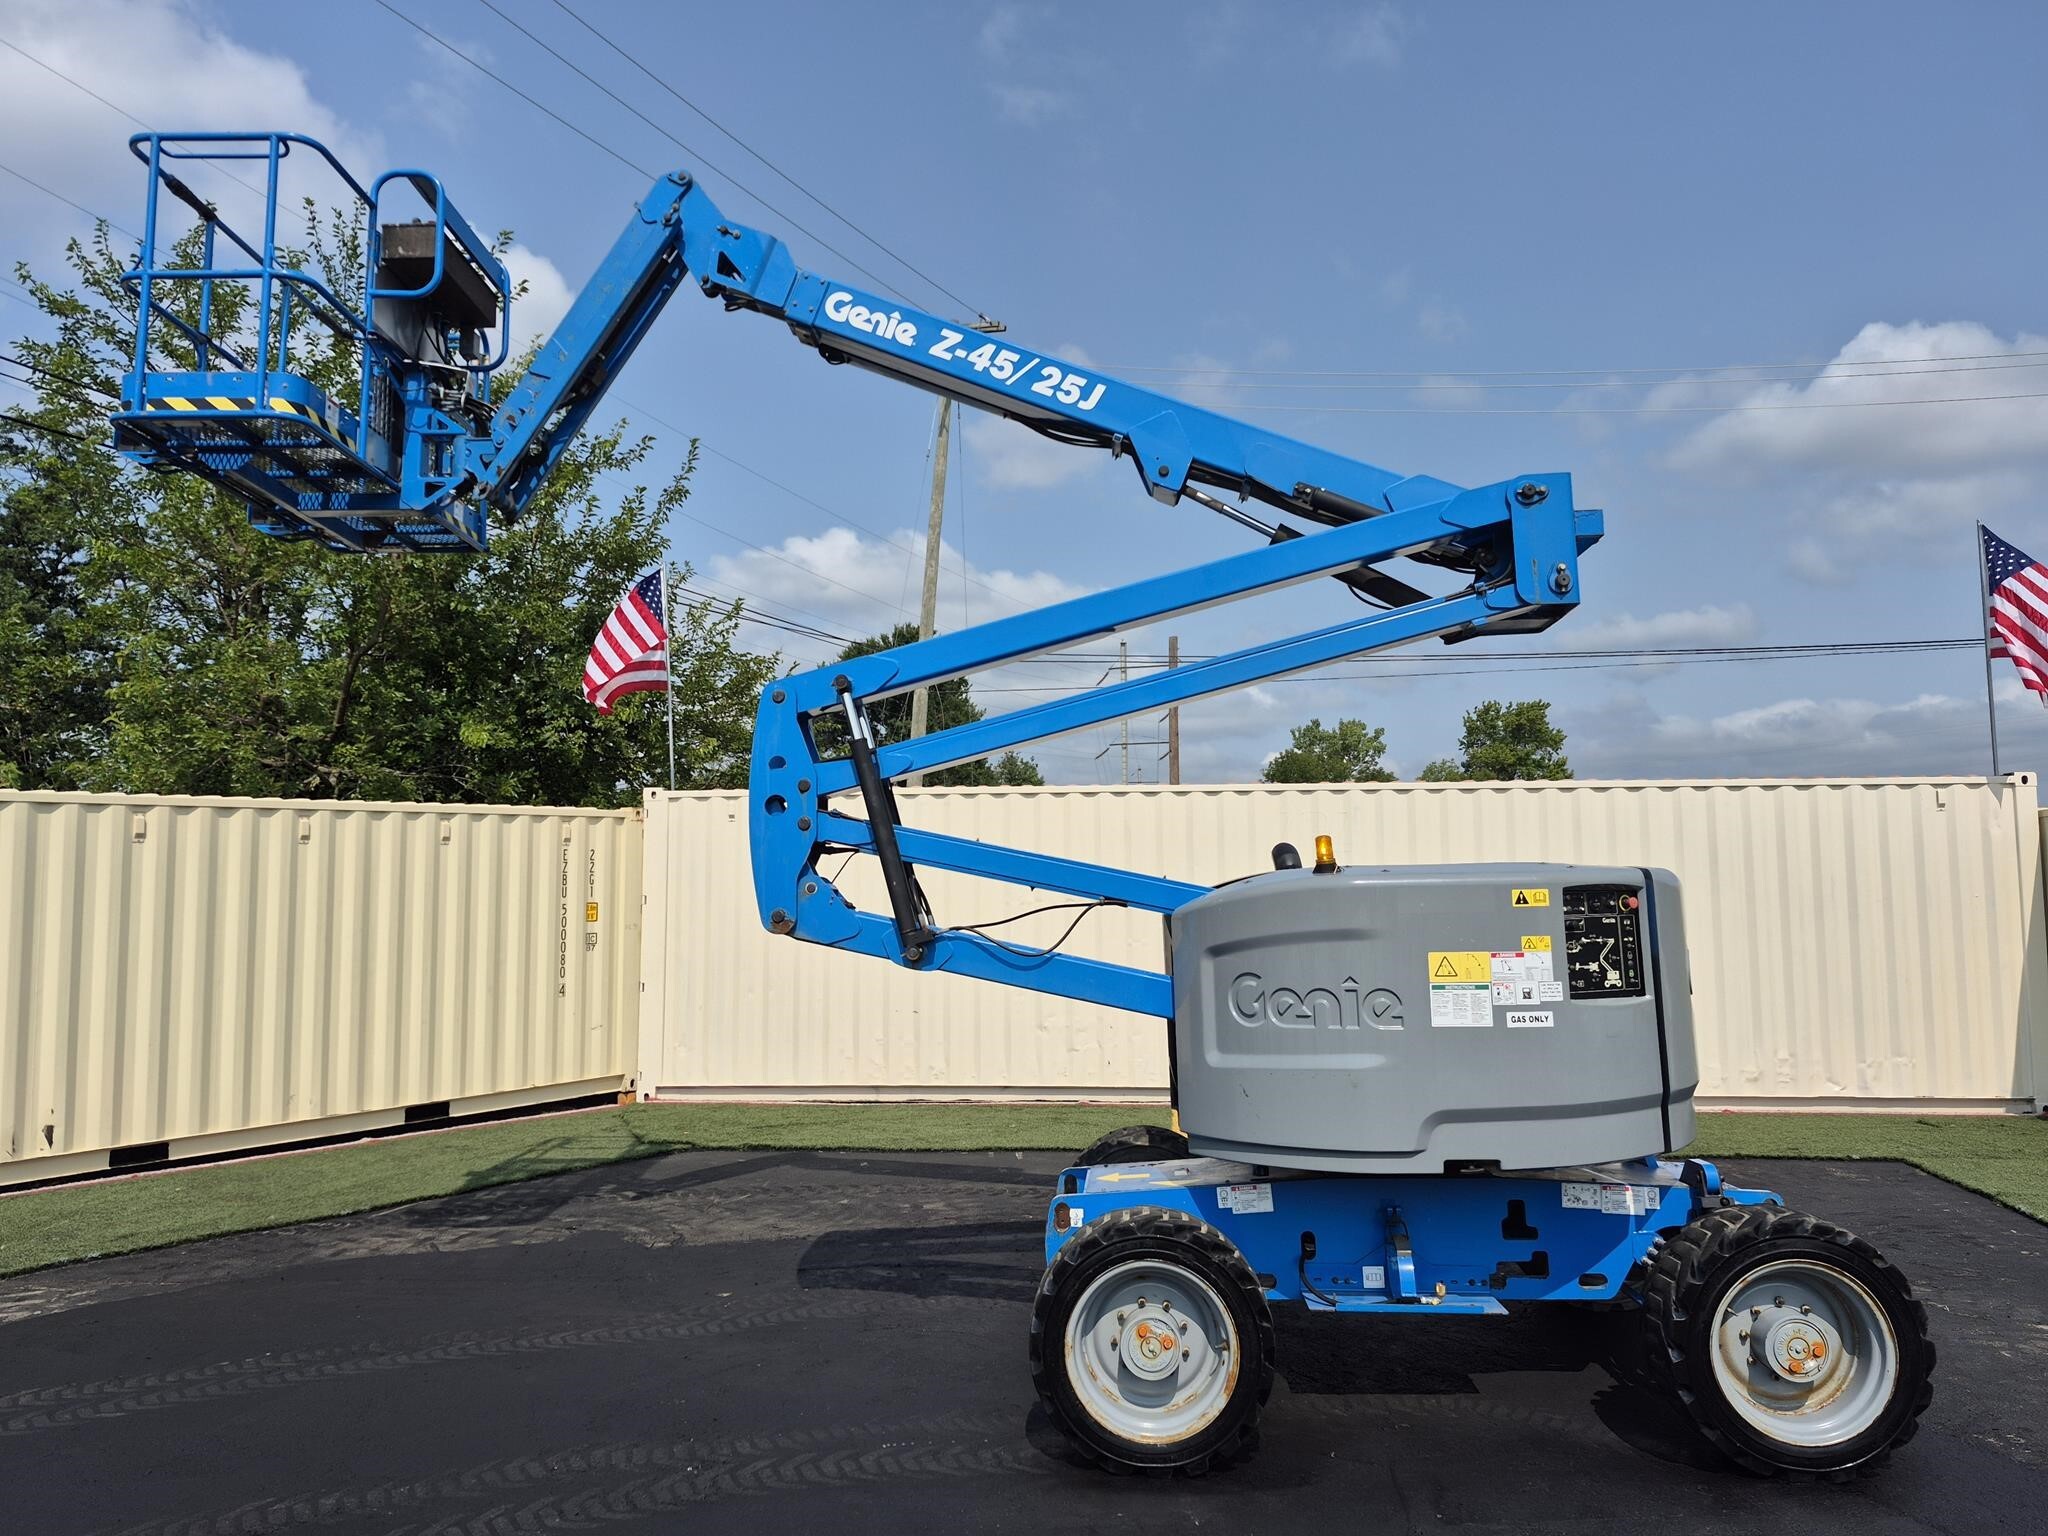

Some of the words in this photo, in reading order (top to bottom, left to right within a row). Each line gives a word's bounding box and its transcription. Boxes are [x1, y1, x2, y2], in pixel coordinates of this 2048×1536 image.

[559, 984, 565, 996] 4
[1511, 1015, 1527, 1024] GAS
[1529, 1014, 1549, 1023] ONLY
